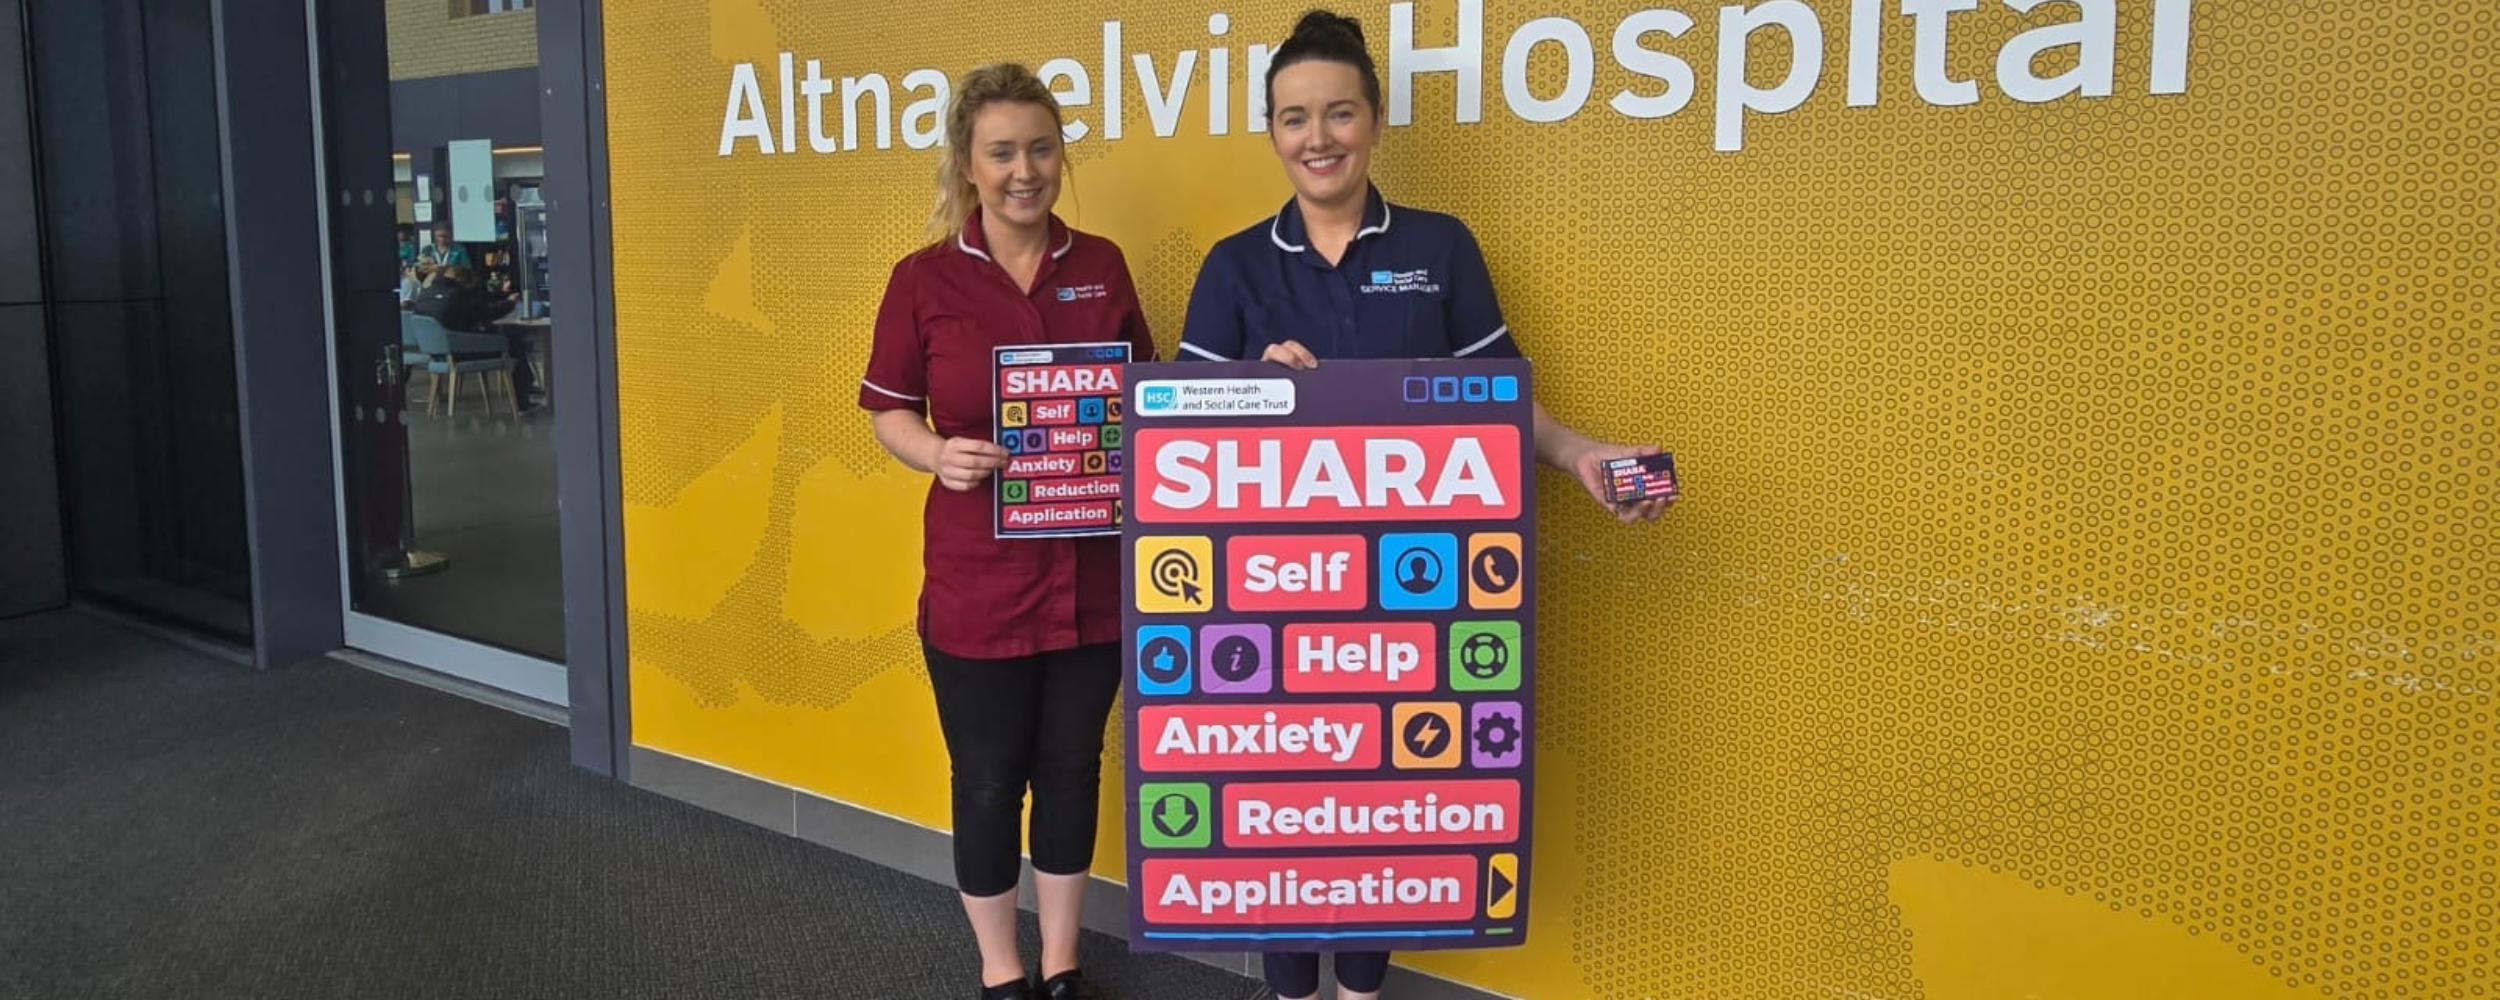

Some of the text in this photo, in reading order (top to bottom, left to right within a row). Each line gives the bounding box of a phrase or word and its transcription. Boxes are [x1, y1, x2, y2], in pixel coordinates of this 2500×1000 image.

[719, 0, 2189, 156] Altnaelvi Hospital
[1006, 368, 1119, 394] SHARA
[1182, 384, 1261, 395] Western Health
[1146, 392, 1171, 403] HSC
[1182, 399, 1288, 410] and Social Care Trust
[1036, 404, 1071, 419] Self
[1053, 429, 1093, 446] Help
[1009, 456, 1076, 473] Anxiety
[1151, 437, 1505, 510] SHARA
[1034, 481, 1120, 498] Reduction
[1009, 505, 1108, 524] Application
[1243, 552, 1350, 593] Self
[1297, 633, 1420, 682] Help
[1155, 711, 1364, 763] Anxiety
[1237, 793, 1505, 836] Reduction
[1159, 867, 1461, 914] Application
